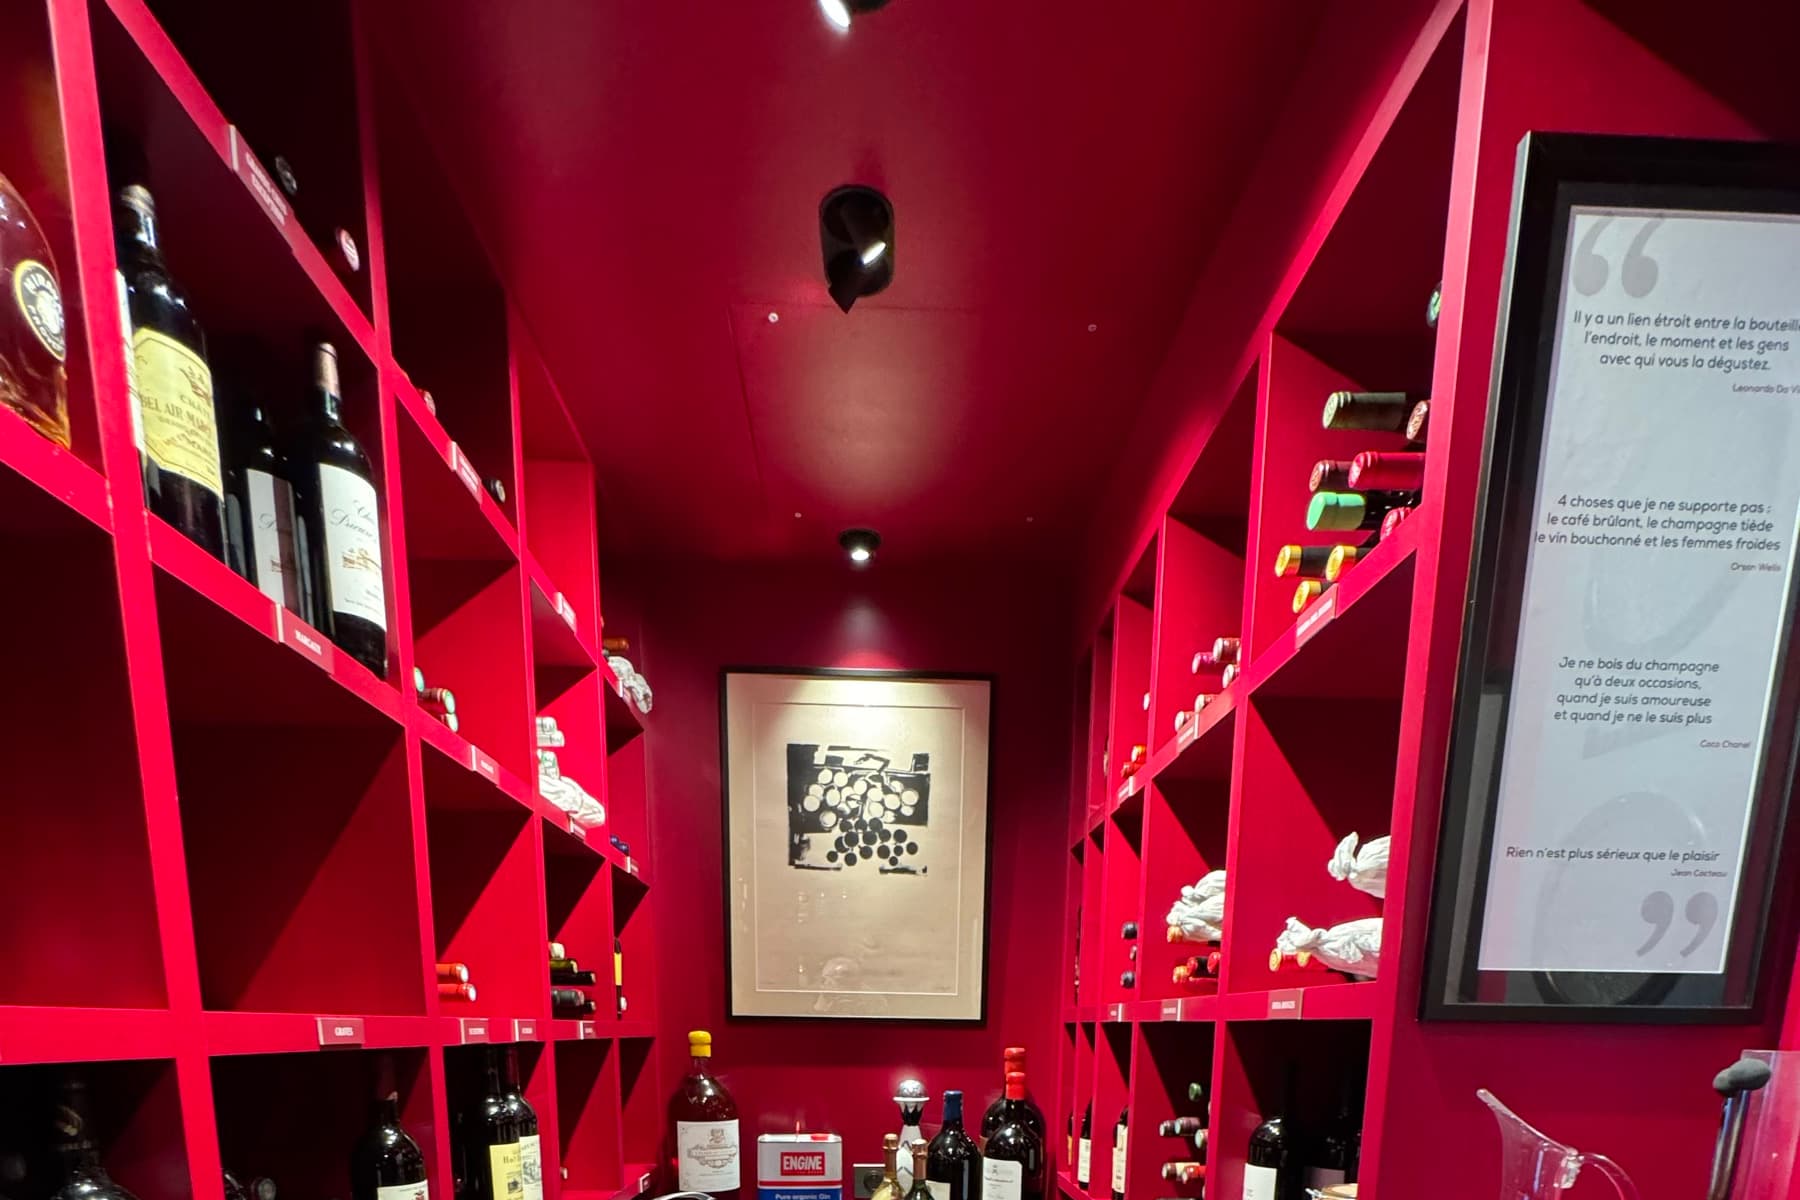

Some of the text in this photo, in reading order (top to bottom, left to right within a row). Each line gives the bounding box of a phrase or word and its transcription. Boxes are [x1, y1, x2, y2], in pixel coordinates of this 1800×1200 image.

[1574, 310, 1581, 323] Il
[1585, 314, 1592, 327] y
[1595, 315, 1603, 324] a
[1608, 316, 1624, 324] un
[1628, 313, 1650, 326] lien
[1655, 314, 1690, 328] étroit
[1694, 318, 1730, 329] entre
[1734, 317, 1746, 330] la
[1585, 331, 1789, 355] l'endroit, le moment et les gens
[1600, 355, 1631, 365] avec
[1634, 354, 1655, 369] qui
[1659, 357, 1688, 367] vous
[1692, 355, 1704, 368] la
[1558, 495, 1566, 506] 4
[1570, 496, 1614, 508] choses
[1617, 500, 1641, 511] que
[1642, 498, 1656, 513] je
[1659, 501, 1675, 510] ne
[1679, 502, 1737, 514] supporte
[1740, 504, 1764, 515] pas
[1547, 512, 1773, 534] le café brûlant, le champagne tiède
[1533, 531, 1780, 550] le vin bouchonné et les femmes froides
[1559, 657, 1719, 676] Je ne bois du champagne
[1575, 676, 1702, 690] qu'à deux occasions,
[1557, 693, 1711, 707] quand je suis amoureuse
[1554, 710, 1712, 726] et quand je ne le suis plus
[1507, 847, 1720, 863] Rien n'est plus sérieux que le plaisir
[783, 1155, 822, 1170] ENGINE
